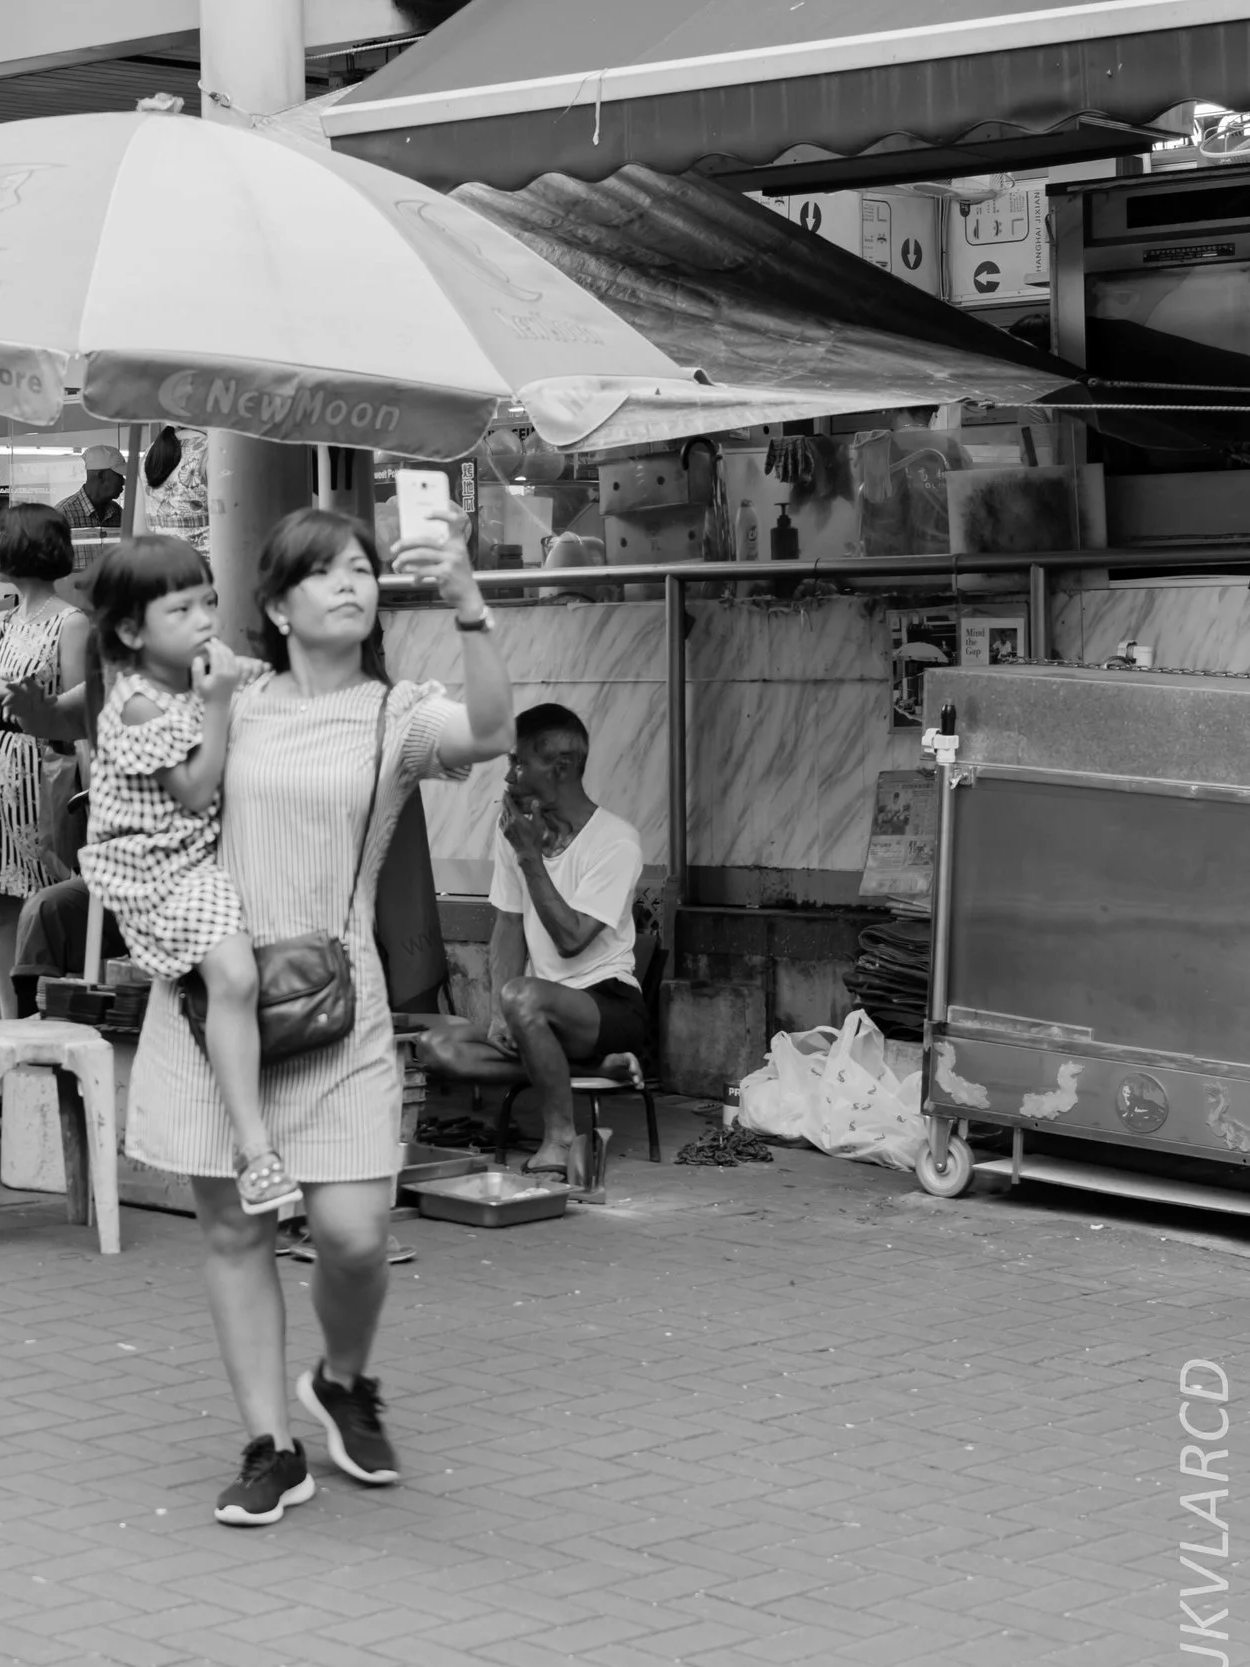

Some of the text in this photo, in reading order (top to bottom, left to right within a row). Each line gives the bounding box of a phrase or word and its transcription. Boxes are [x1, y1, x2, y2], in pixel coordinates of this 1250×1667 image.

[1034, 227, 1042, 273] HANGHAI
[374, 470, 387, 480] weet
[965, 628, 985, 637] Mind
[965, 637, 978, 646] the
[965, 647, 981, 658] Gap
